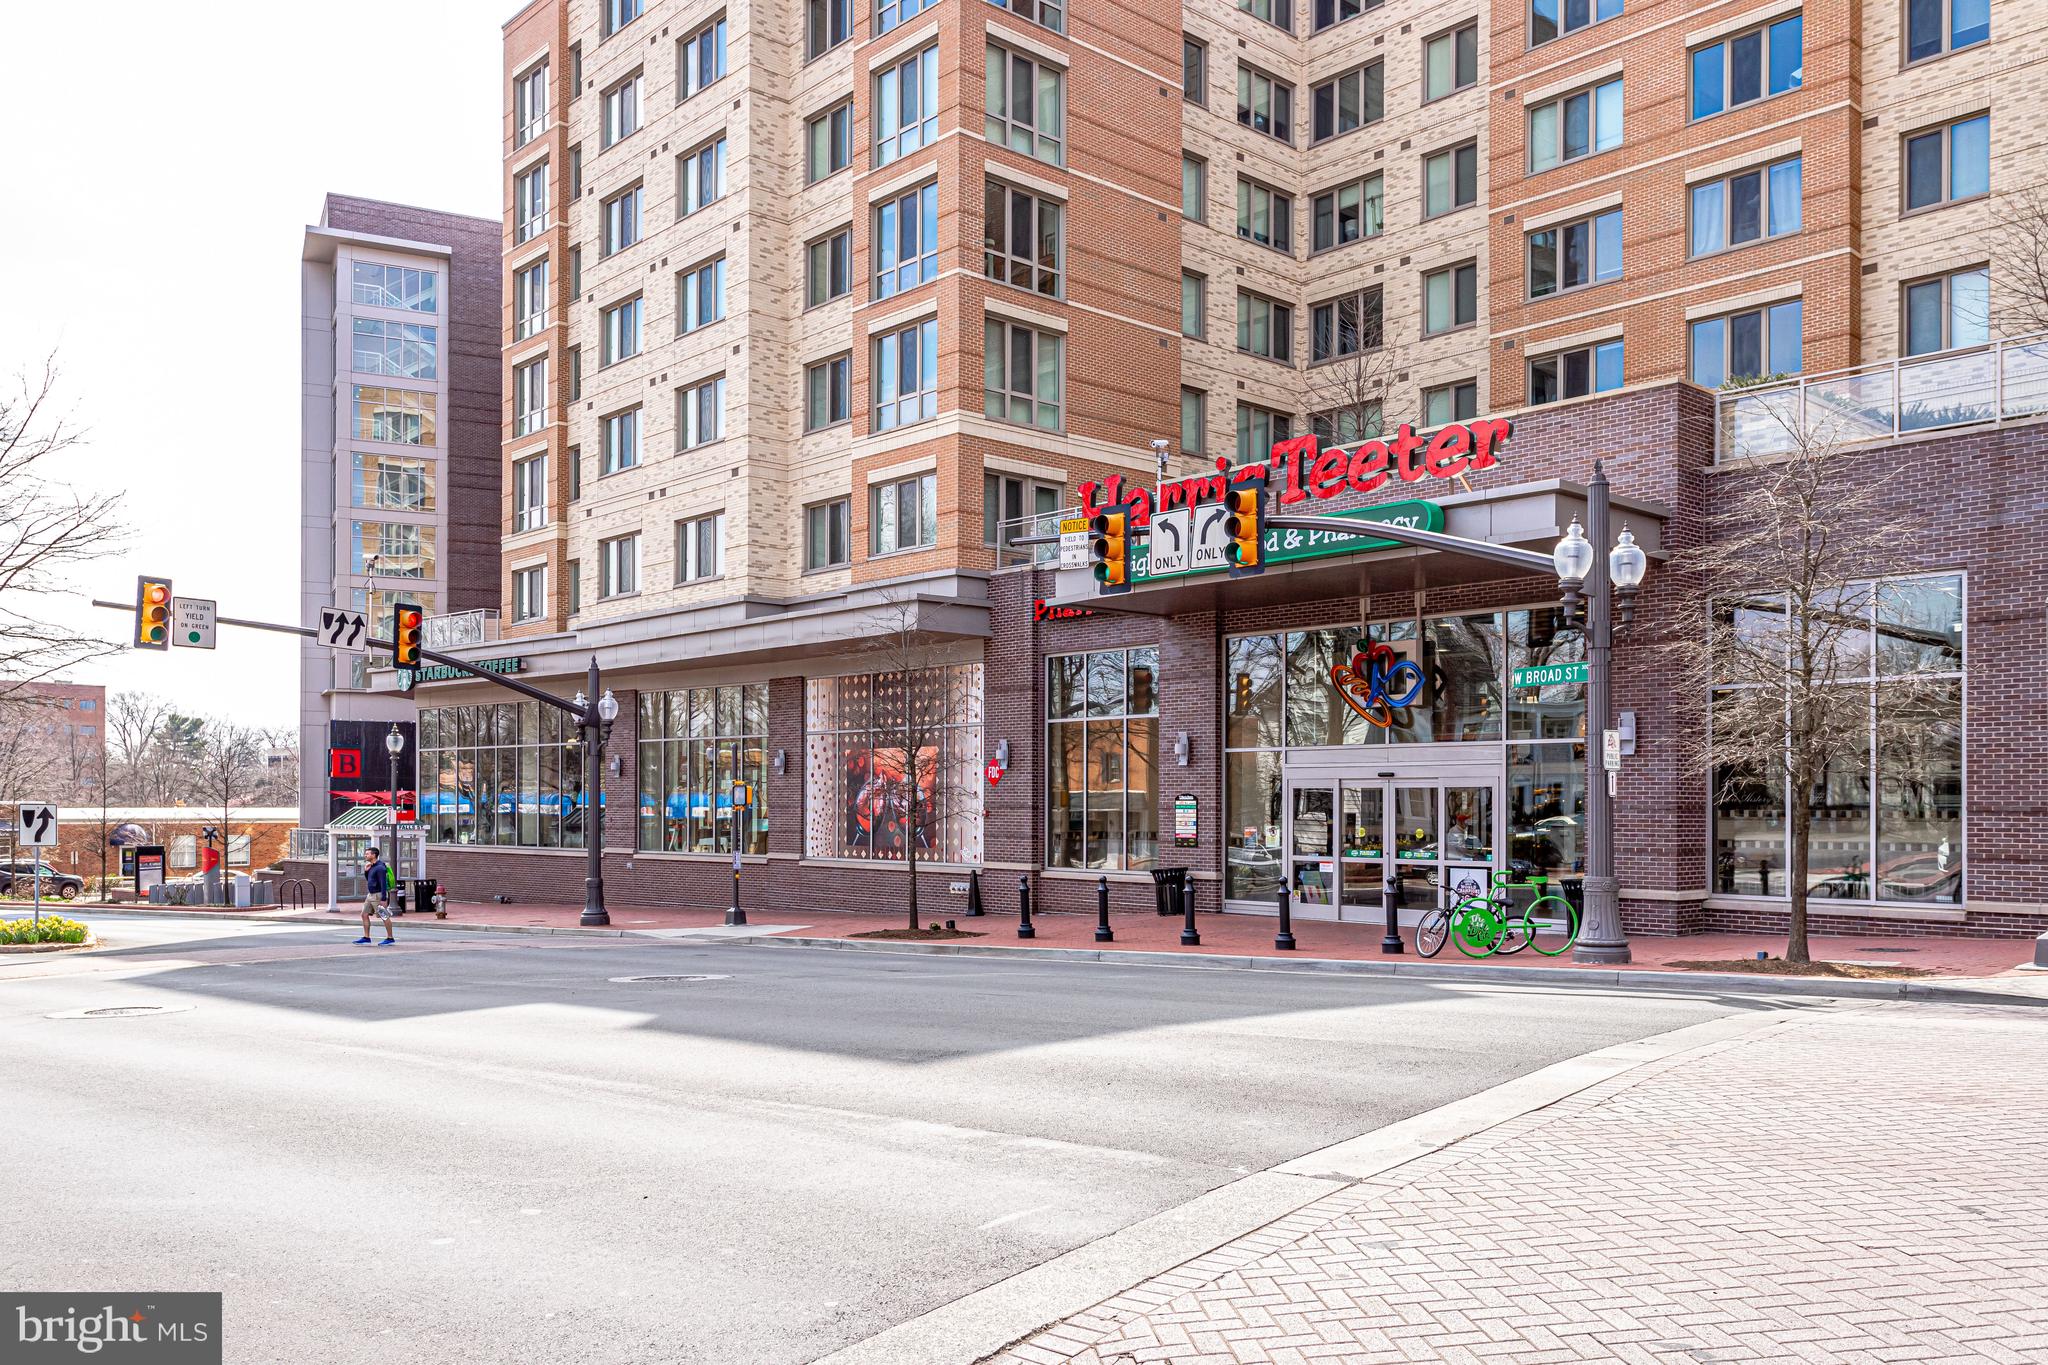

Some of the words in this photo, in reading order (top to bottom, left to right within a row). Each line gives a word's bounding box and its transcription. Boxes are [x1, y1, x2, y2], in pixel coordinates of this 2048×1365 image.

[1271, 417, 1513, 505] Teeter
[1063, 520, 1087, 531] NOTICE
[1283, 528, 1304, 549] &
[1308, 516, 1420, 546] Phacy
[1060, 544, 1088, 552] PEDESTRIANS
[1195, 547, 1226, 561] ONLY
[1060, 561, 1088, 569] CROSSWALKS
[1155, 554, 1183, 570] ONLY
[479, 657, 519, 673] COFFEE
[1514, 671, 1522, 685] W
[1526, 668, 1562, 684] BROAD
[1565, 666, 1579, 680] ST
[1606, 752, 1618, 760] PUBLIC
[340, 753, 357, 774] B
[1605, 760, 1620, 768] PARKING
[988, 766, 1000, 779] FDC
